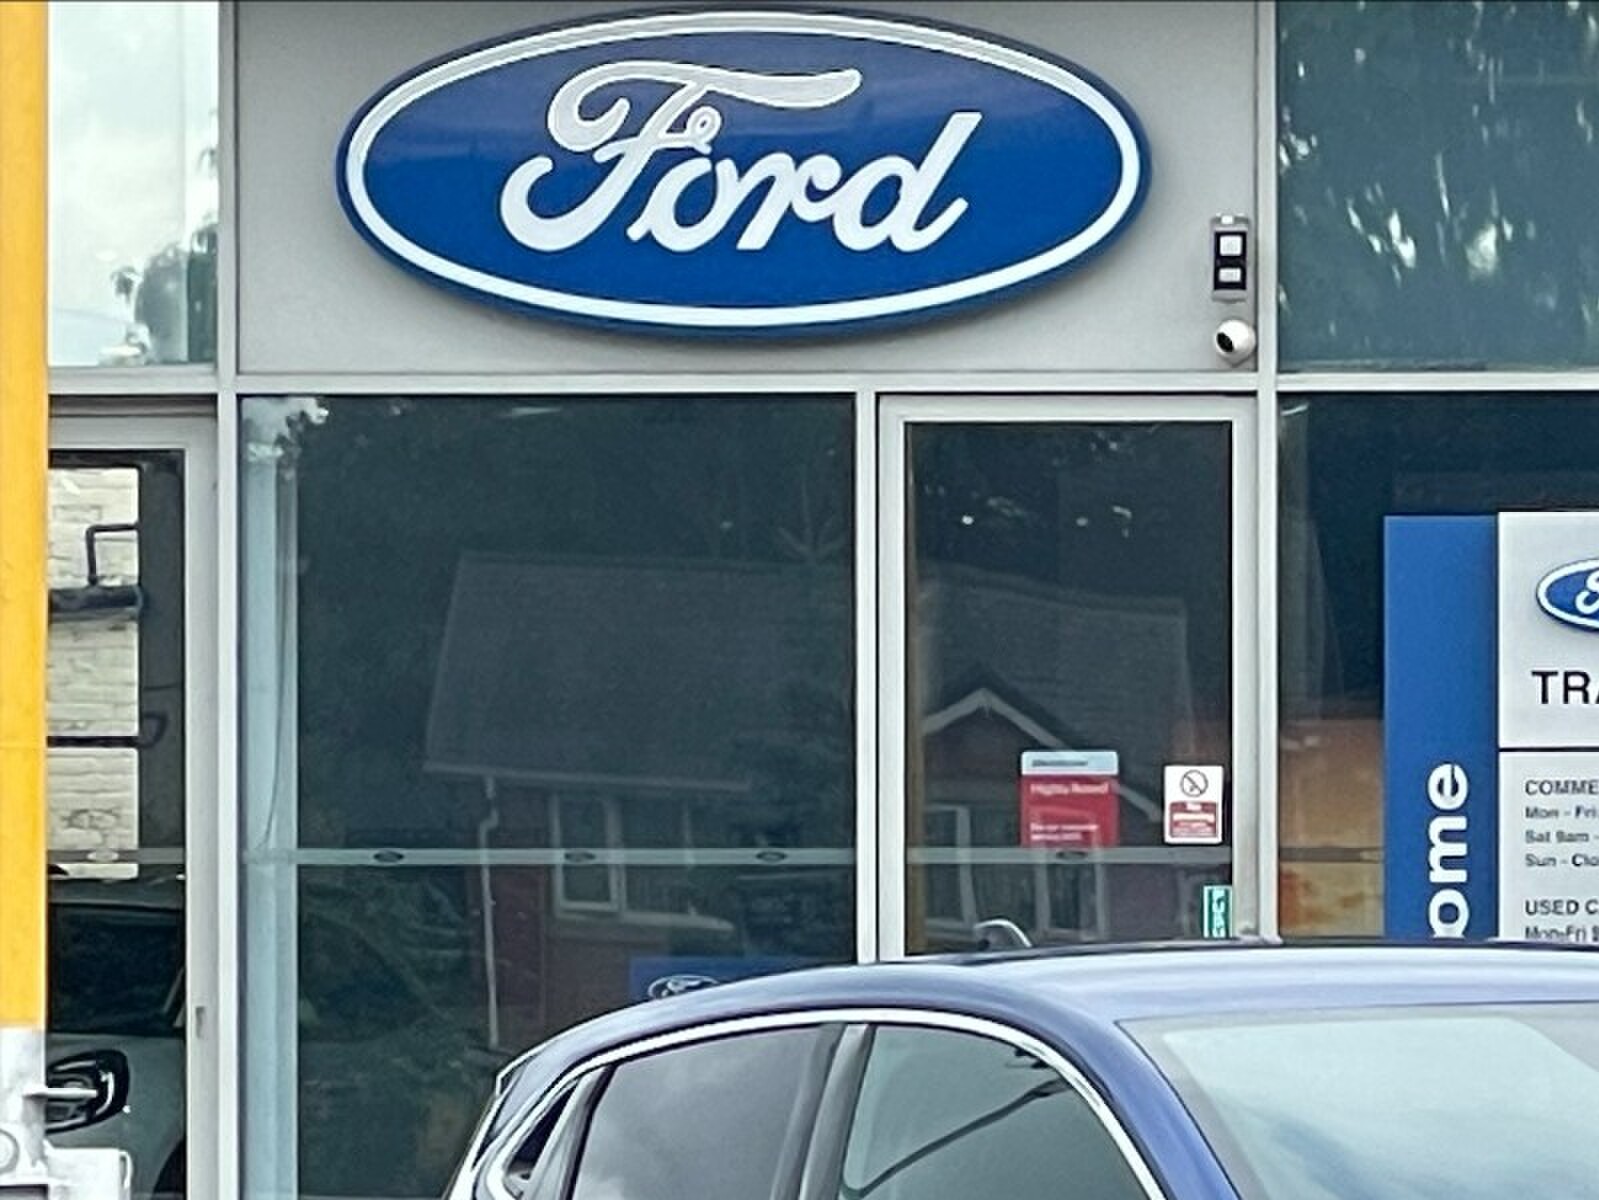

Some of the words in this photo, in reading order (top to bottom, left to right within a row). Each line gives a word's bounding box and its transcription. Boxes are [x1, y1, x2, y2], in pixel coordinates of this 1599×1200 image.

[499, 60, 982, 253] Ford
[1525, 806, 1559, 818] Mon
[1525, 829, 1551, 843] Sat
[1525, 852, 1557, 867] Sun
[1525, 898, 1580, 916] USED
